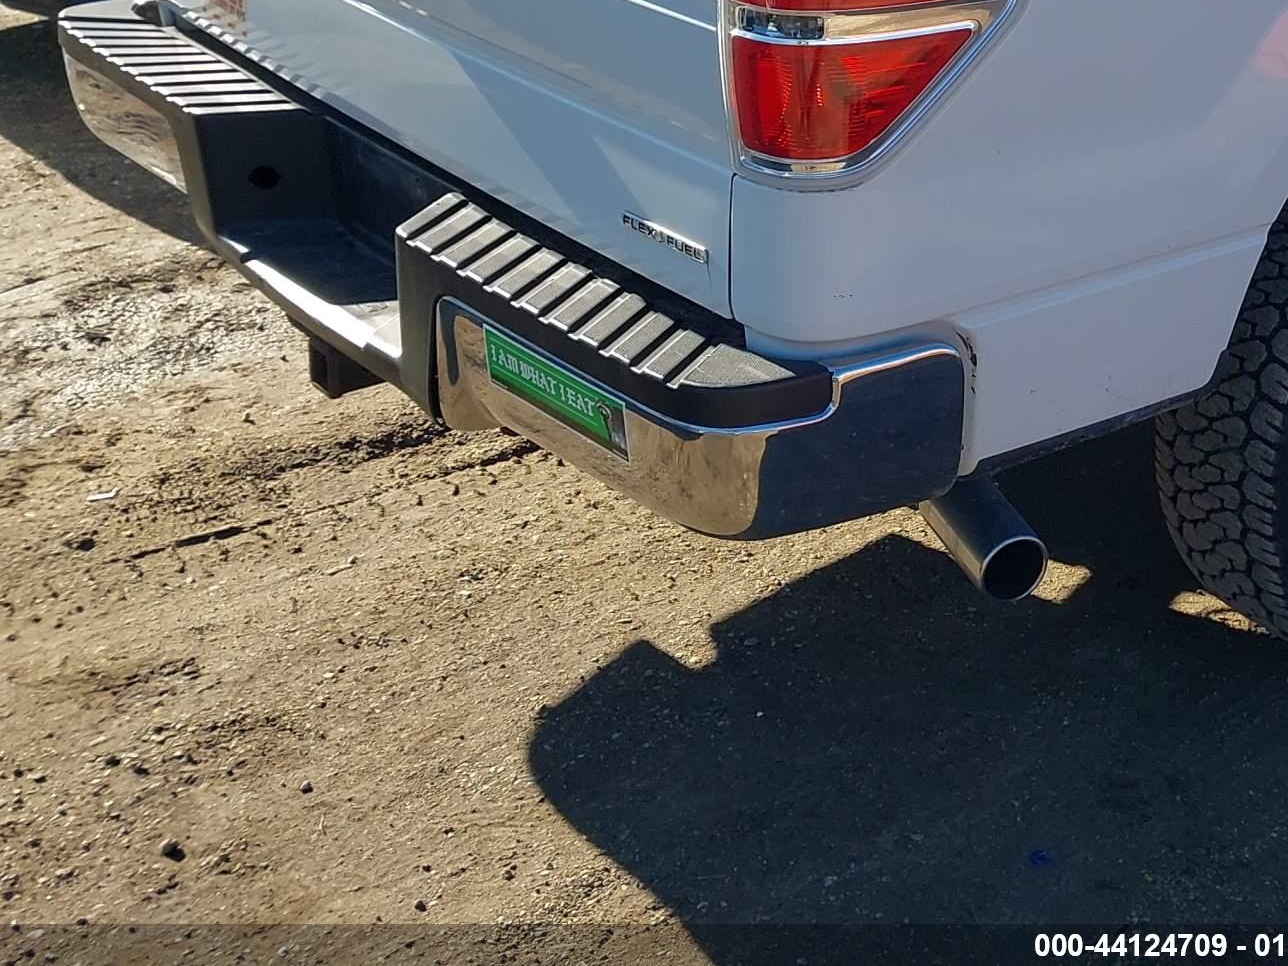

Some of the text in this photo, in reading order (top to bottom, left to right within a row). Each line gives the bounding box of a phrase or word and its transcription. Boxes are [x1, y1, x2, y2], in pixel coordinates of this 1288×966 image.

[622, 214, 705, 261] FLEX FUEL
[491, 344, 596, 417] I AM WHAT I EAT
